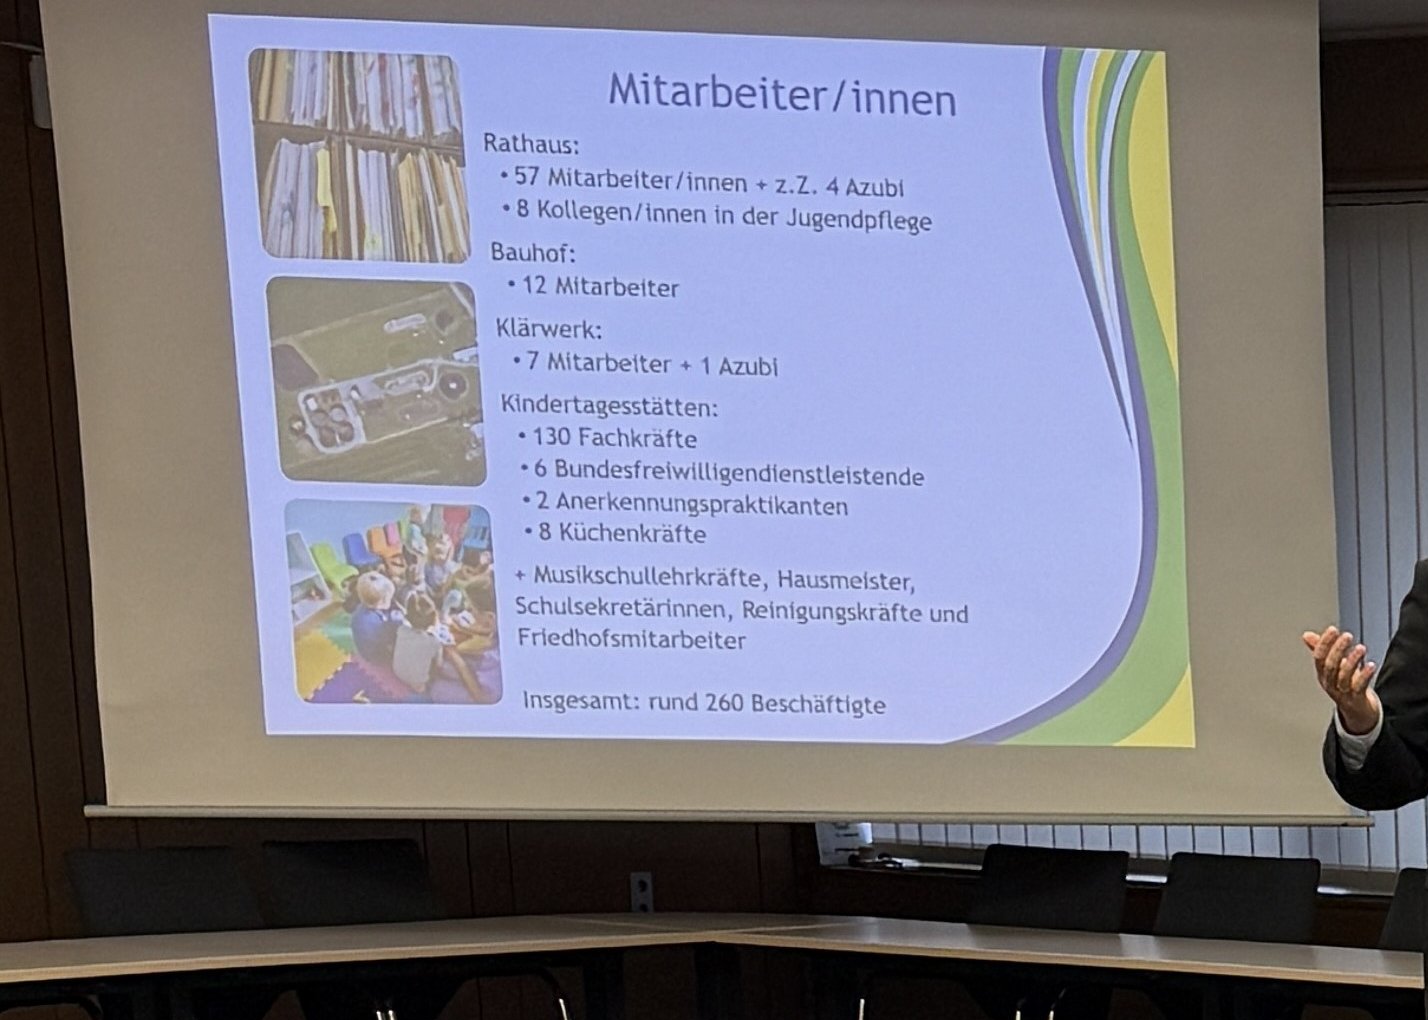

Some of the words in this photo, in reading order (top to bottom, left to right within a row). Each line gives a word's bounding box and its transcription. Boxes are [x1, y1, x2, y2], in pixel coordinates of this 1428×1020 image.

[610, 72, 956, 116] Mitarbeiter/innen
[484, 132, 579, 155] Rathaus:
[514, 166, 540, 186] 57
[549, 168, 748, 193] Mitarbeiter/innen
[776, 175, 818, 195] z.Z.
[826, 177, 840, 195] 4
[846, 179, 905, 198] Azubi
[516, 199, 530, 218] 8
[538, 199, 707, 225] Kollegen/innen
[715, 205, 735, 224] in
[743, 206, 780, 226] der
[787, 208, 933, 236] Jugendpflege
[491, 241, 576, 264] Bauhof:
[523, 275, 548, 295] 12
[556, 276, 680, 298] Mitarbeiter
[496, 317, 602, 340] Klärwerk:
[527, 351, 540, 370] 7
[548, 352, 673, 374] Mitarbeiter
[702, 357, 710, 375] 1
[719, 357, 778, 377] Azubi
[501, 394, 719, 419] Kindertagesstätten:
[534, 427, 572, 446] 130
[579, 427, 698, 449] Fachkräfte
[534, 459, 548, 478] 6
[555, 459, 925, 487] Bundesfreiwilligendienstleistende
[536, 491, 549, 510] 2
[556, 492, 849, 518] Anerkennungspraktikanten
[538, 522, 552, 541] 8
[559, 522, 707, 545] Küchenkräfte
[534, 565, 769, 592] Musikschullehrkräfte,
[777, 570, 915, 595] Hausmeister,
[515, 596, 733, 622] Schulsekretärinnen,
[743, 600, 922, 625] Reinigungskräfte
[930, 605, 969, 625] und
[518, 628, 747, 650] Friedhofsmitarbeiter
[523, 691, 640, 714] Insgesamt:
[649, 692, 699, 712] rund
[706, 693, 744, 712] 260
[752, 694, 887, 719] Beschäftigte
